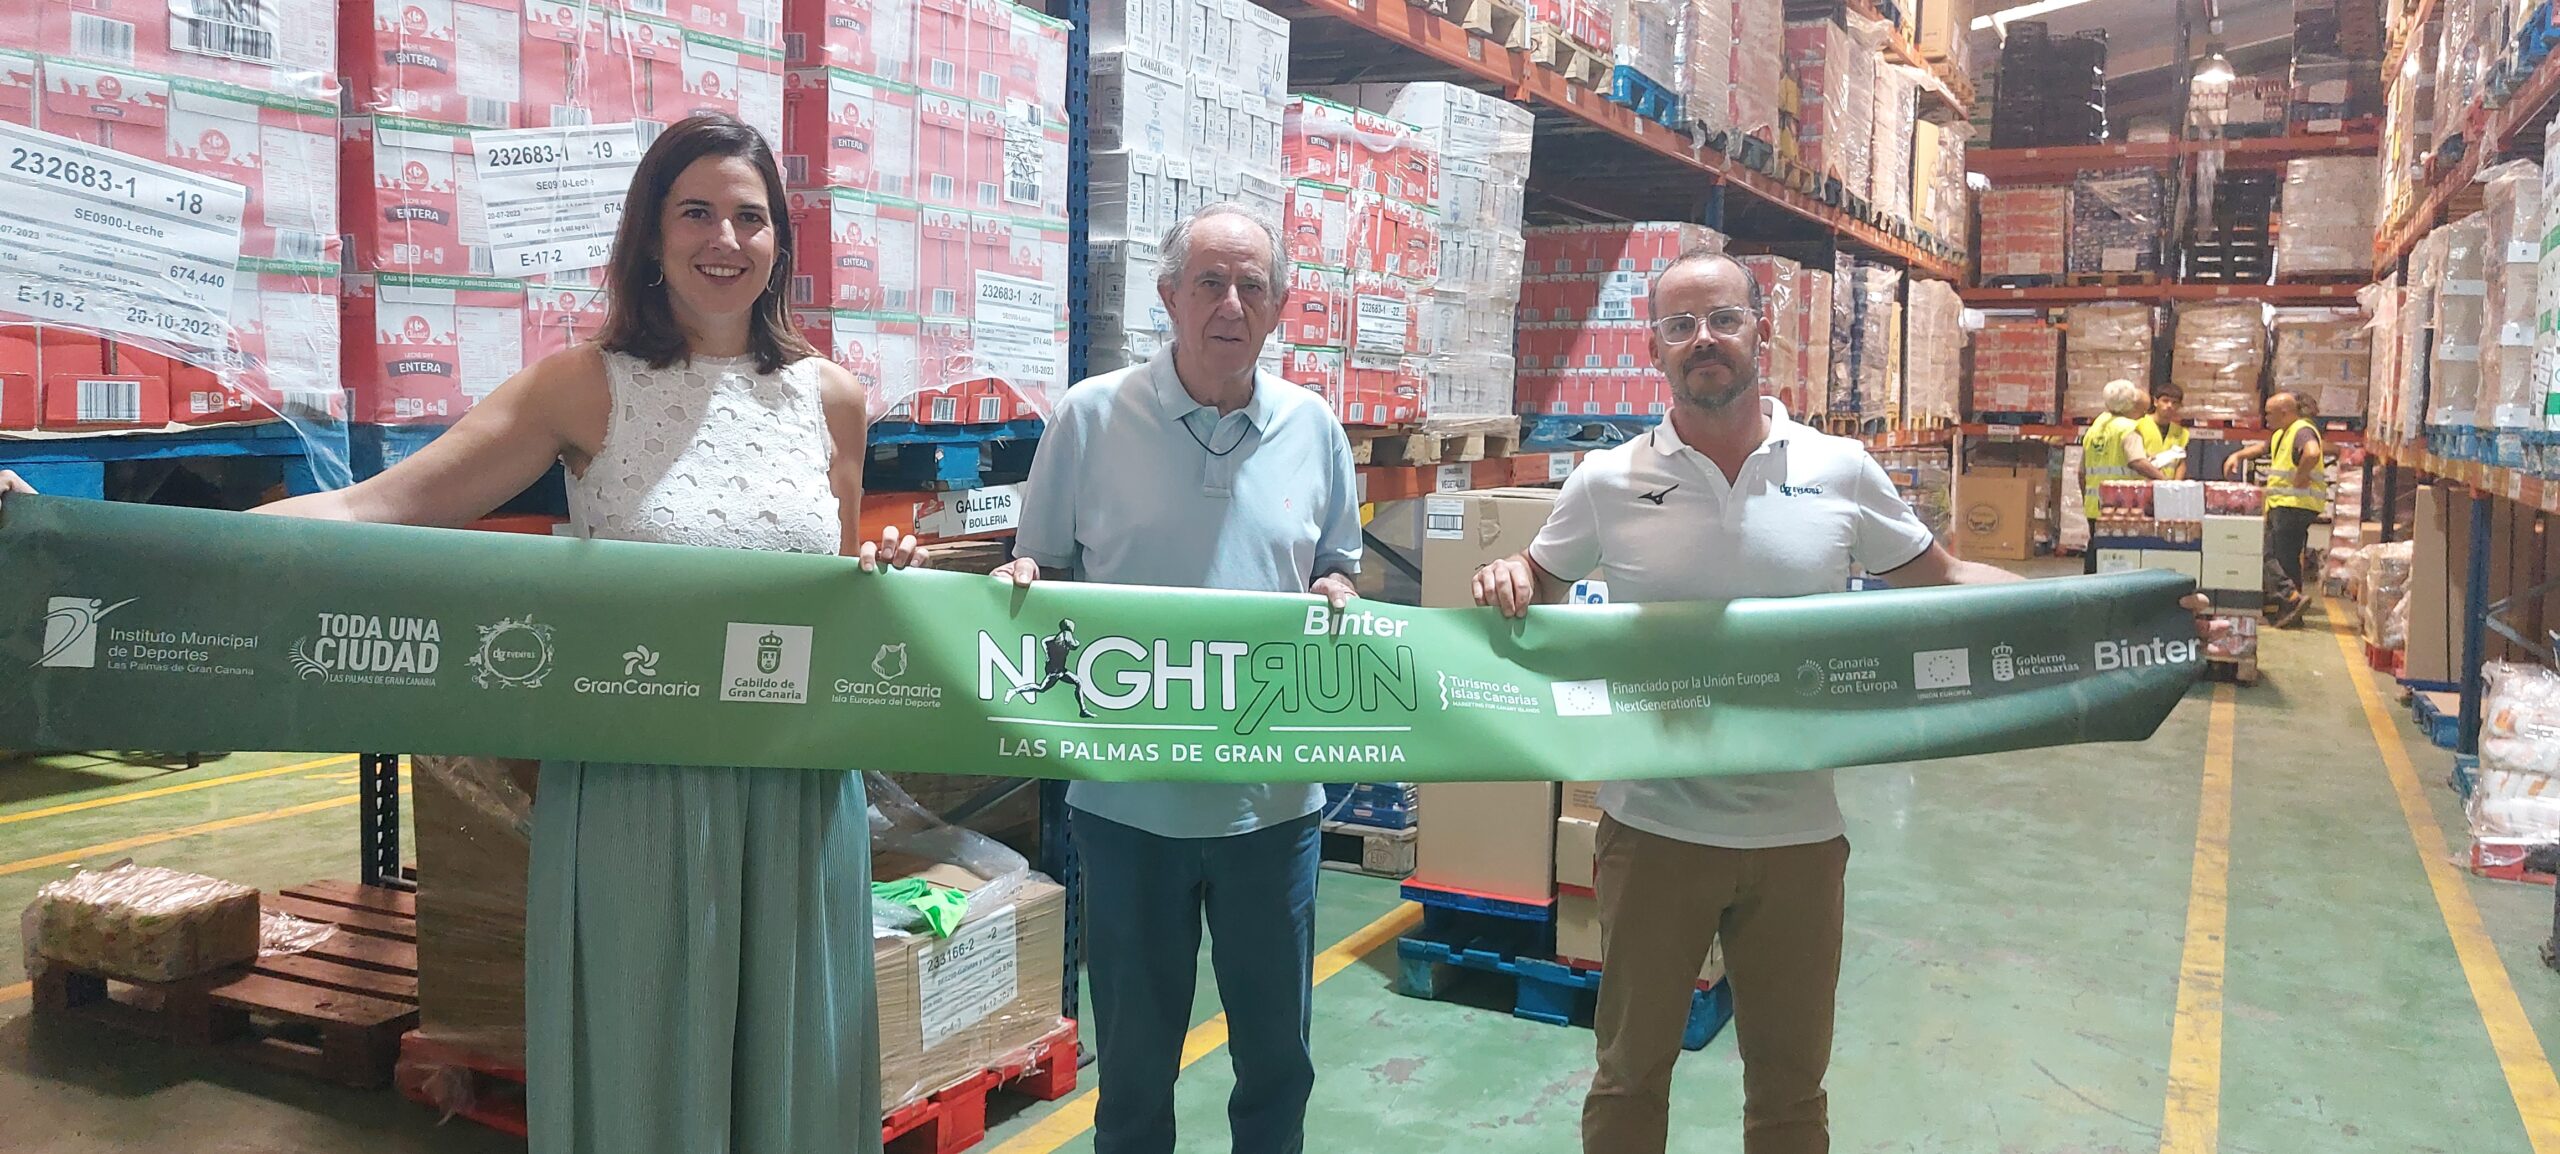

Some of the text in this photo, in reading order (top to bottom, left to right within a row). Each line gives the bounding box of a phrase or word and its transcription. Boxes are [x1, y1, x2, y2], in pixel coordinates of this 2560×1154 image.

[396, 52, 437, 68] ENTERA
[488, 144, 570, 167] 232683-1
[587, 141, 613, 160] -19
[11, 147, 137, 199] 232683-1
[166, 188, 204, 216] -18
[74, 207, 164, 239] SE0900-Leche
[396, 207, 439, 221] ENTERA
[520, 249, 563, 267] E-17-2
[169, 265, 226, 289] 674,440
[18, 284, 85, 313] E-18-2
[982, 283, 1042, 306] 232683-1 -21
[126, 306, 222, 338] 20-10-2023
[399, 362, 441, 374] ENTERA
[955, 494, 1012, 514] GALLETAS
[961, 513, 1009, 530] Y BOLLERIA
[318, 612, 441, 642] TODA UNA
[1303, 605, 1409, 638] Binter
[110, 627, 259, 649] Instituto Municipal
[108, 645, 209, 662] de Deportes
[314, 636, 440, 674] CIUDAD
[1828, 656, 1880, 669] Canarias
[2016, 652, 2066, 666] Gobierno
[2094, 637, 2201, 671] Binter
[107, 660, 254, 676] Las Palmas de Gran Canaria
[1829, 670, 1876, 682] avanza
[2017, 660, 2080, 676] de Canarias
[330, 674, 344, 683] LAS
[374, 675, 384, 684] DE
[385, 676, 405, 685] GRAN
[573, 677, 700, 697] GranCanaria
[734, 677, 795, 690] Cabildo de
[1449, 675, 1520, 694] Turismo de
[1612, 671, 1781, 695] Financiado por la Unión Europea
[1830, 680, 1898, 694] con Europa
[728, 687, 802, 701] Gran Canaria
[832, 694, 942, 709] Isla Europea del Deporte
[1451, 687, 1539, 706] Islas Canarias
[1615, 695, 1712, 714] NextGenerationEU
[998, 737, 1406, 764] LAS PALMAS DE GRAN CANARIA
[926, 926, 998, 973] 233166-2 -2
